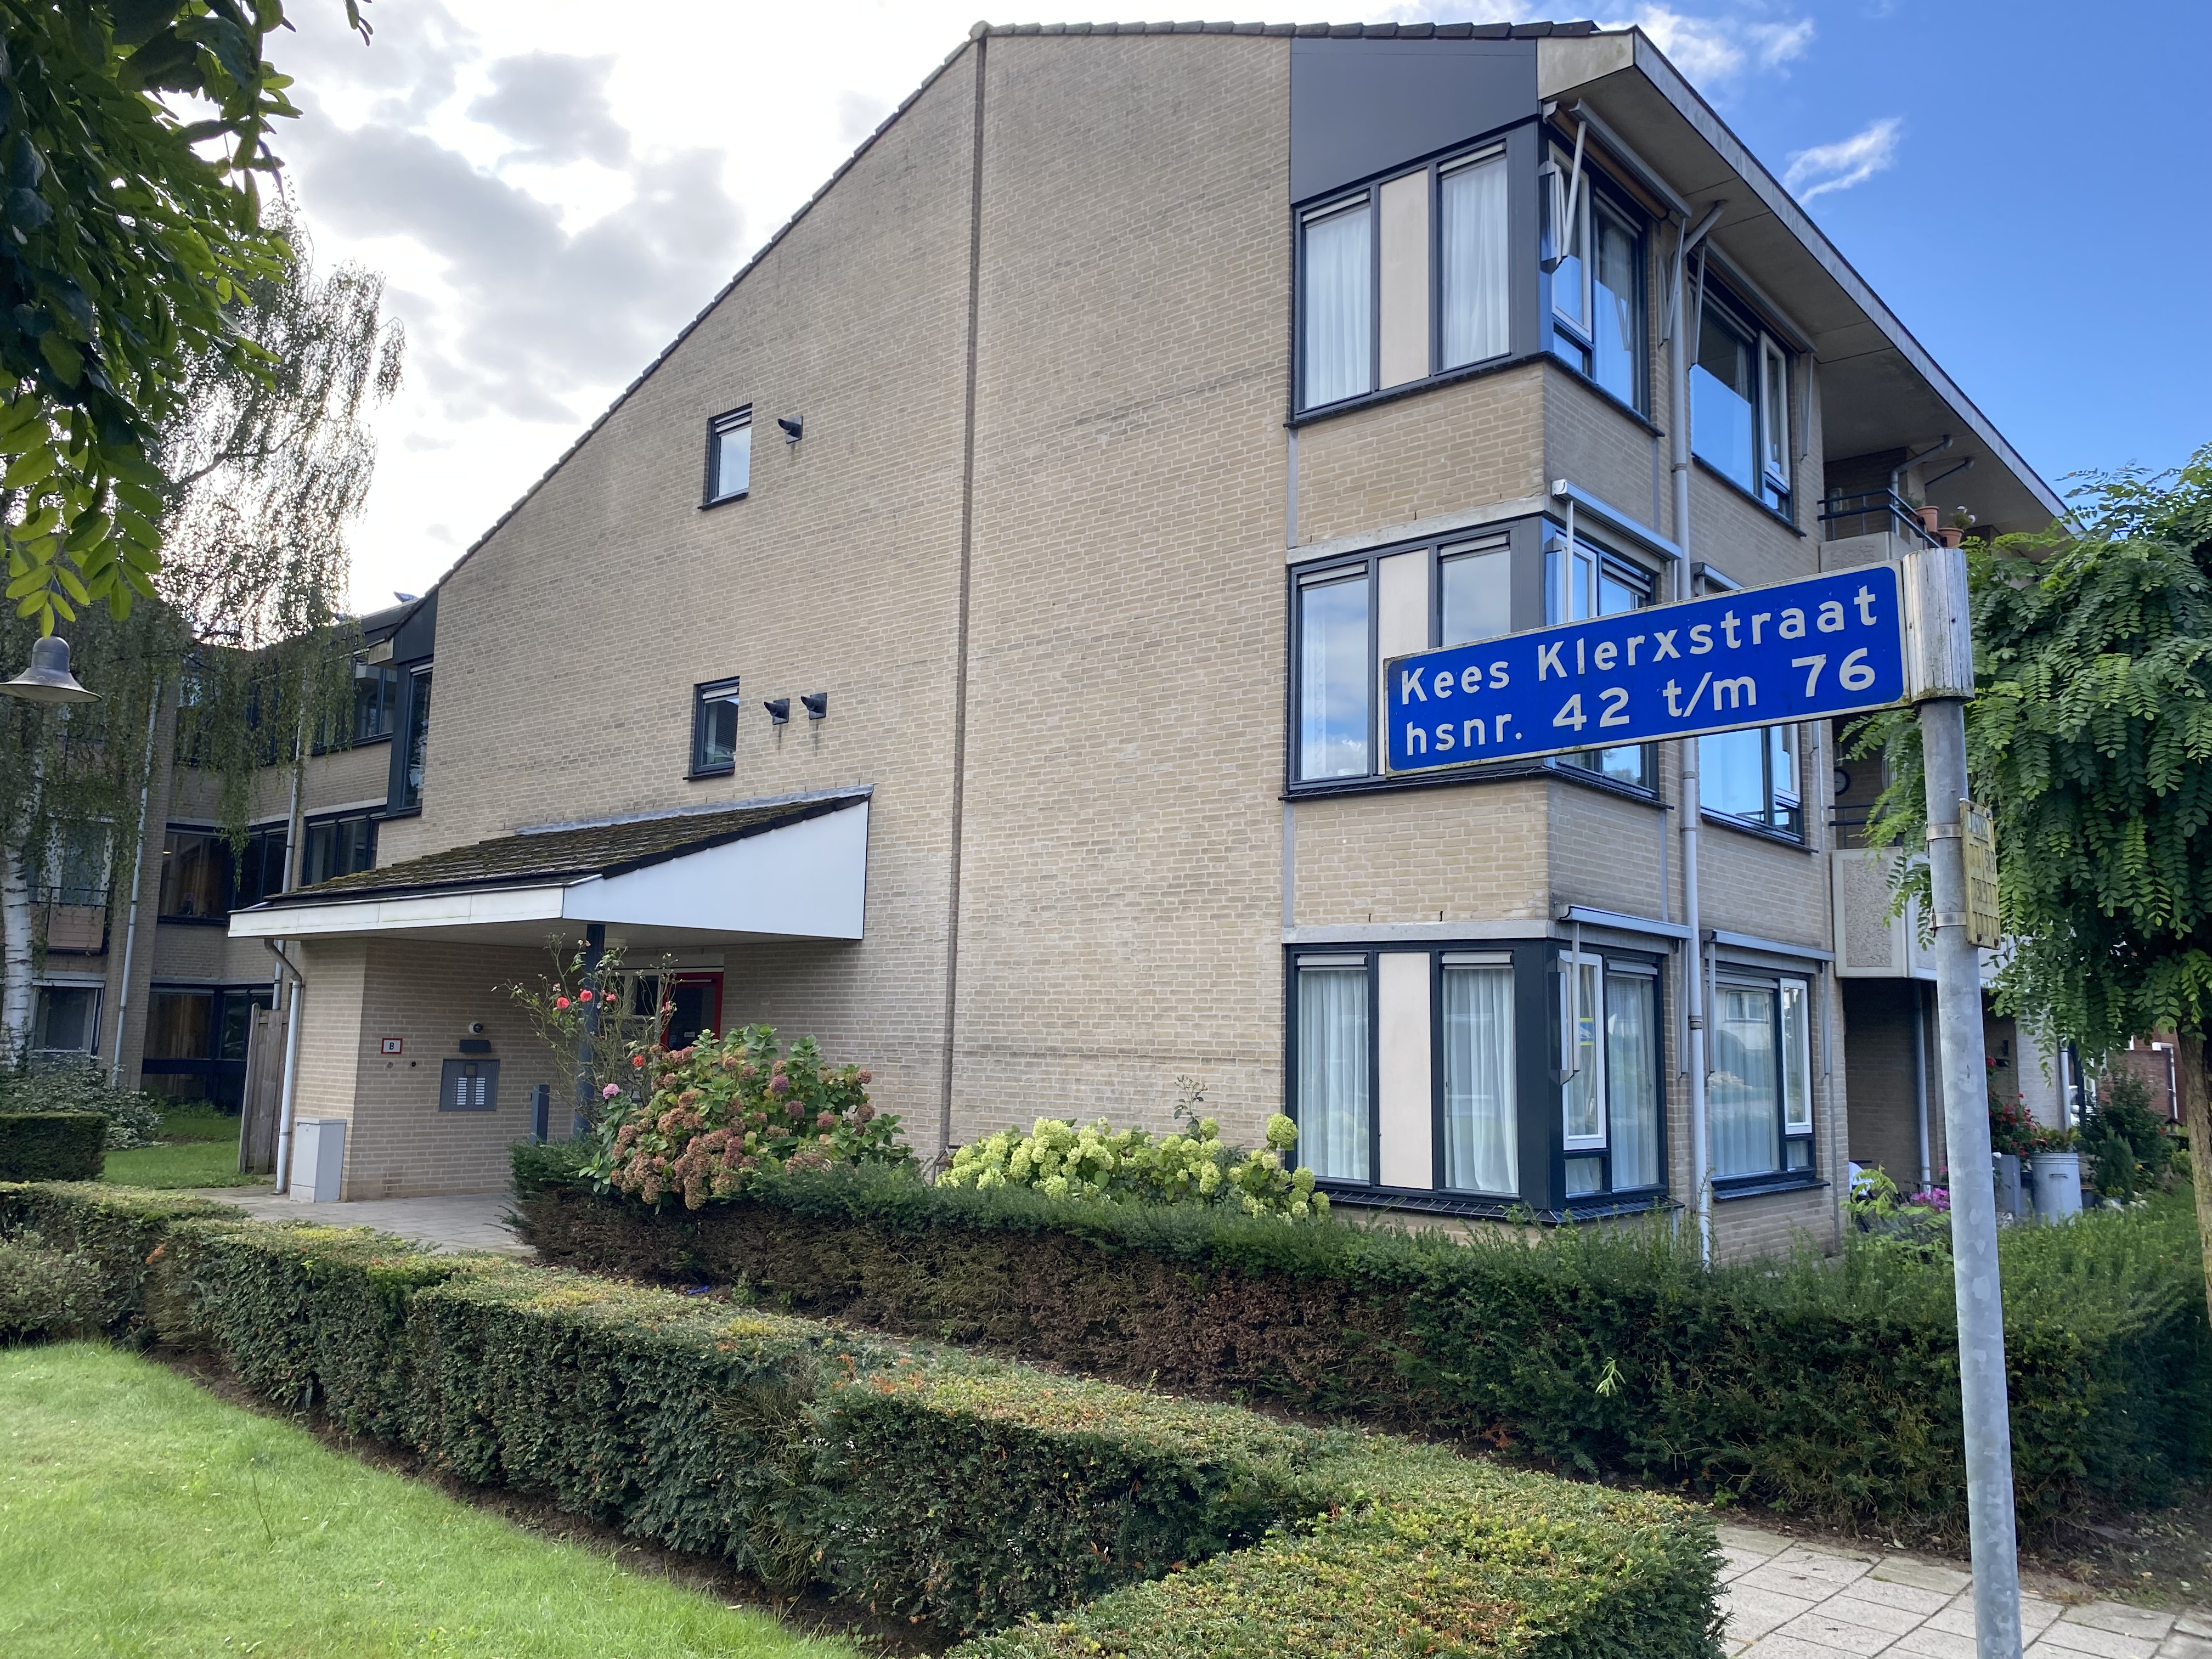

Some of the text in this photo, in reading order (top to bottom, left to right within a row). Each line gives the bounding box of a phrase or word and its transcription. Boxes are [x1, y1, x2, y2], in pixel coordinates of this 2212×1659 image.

[1401, 585, 1877, 706] Kees Klerxstraat
[1406, 647, 1876, 756] hsnr. 42 t/m 76
